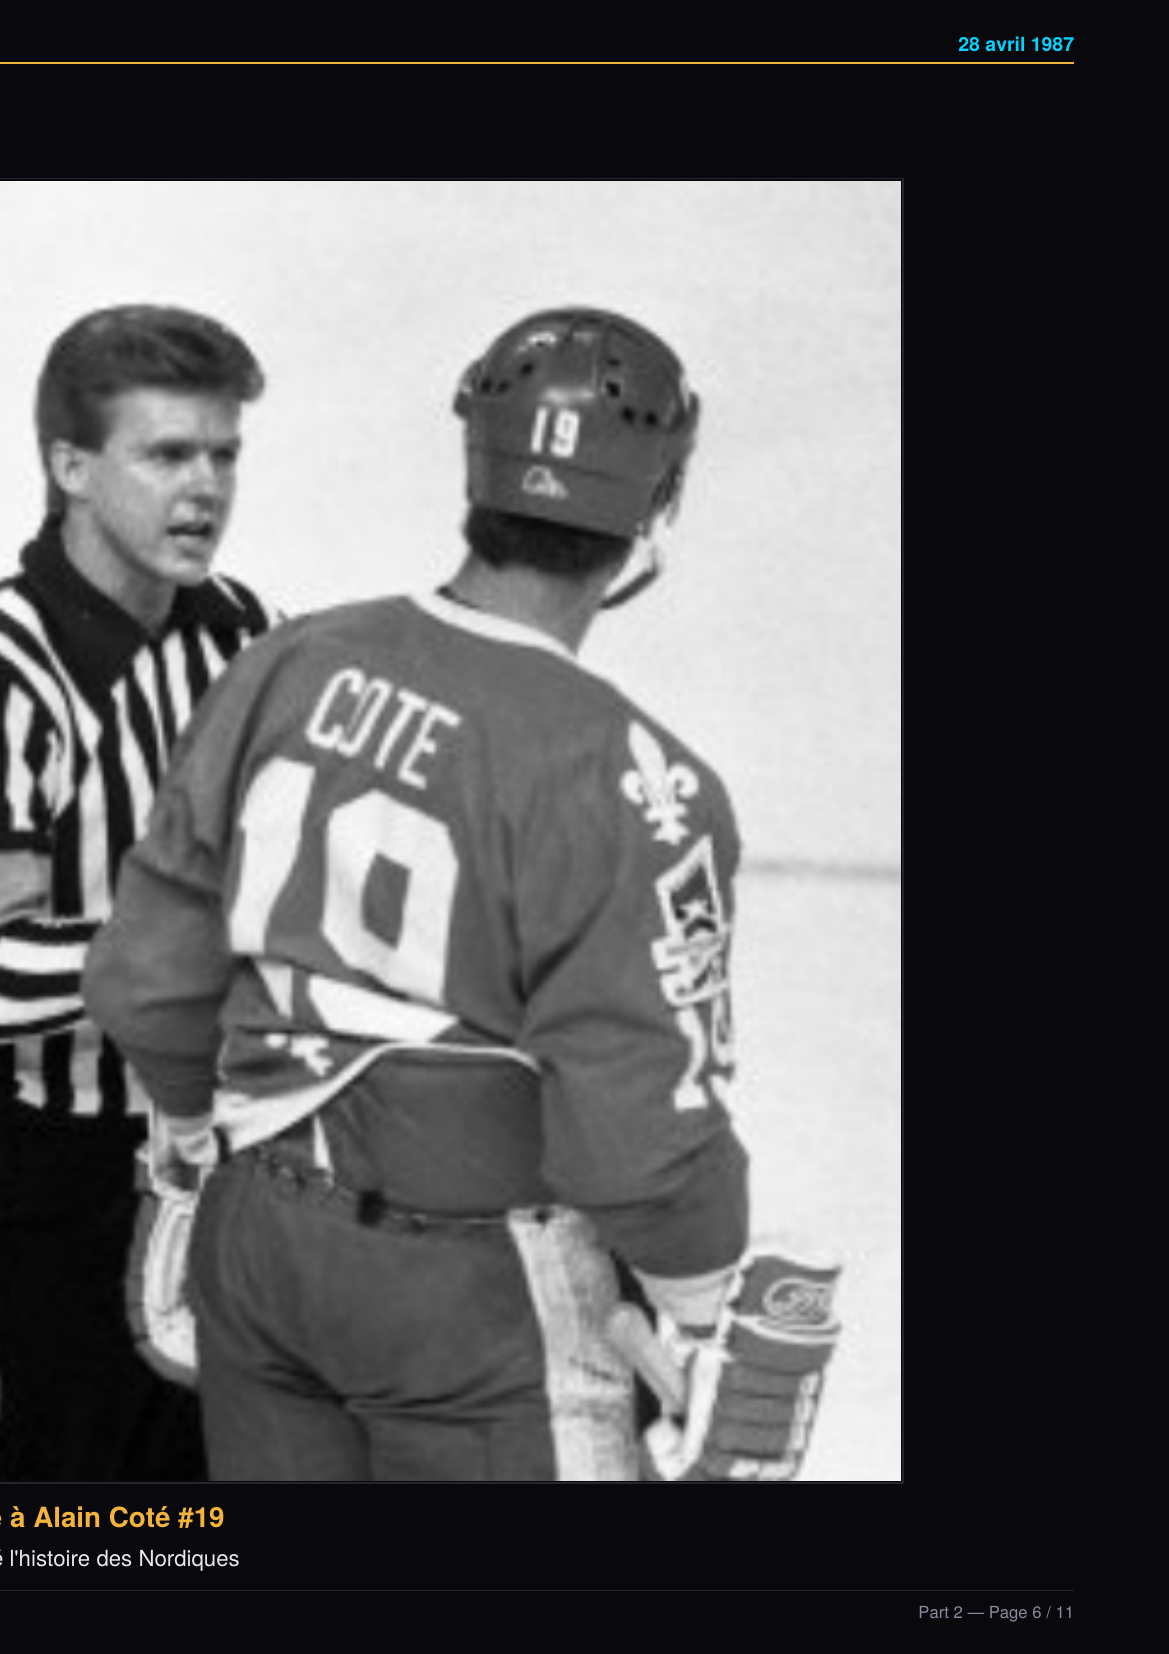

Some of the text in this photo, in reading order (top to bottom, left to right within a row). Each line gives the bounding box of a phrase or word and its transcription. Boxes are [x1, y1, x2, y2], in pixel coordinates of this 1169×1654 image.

[531, 405, 580, 458] 19
[305, 667, 462, 791] COTE
[227, 755, 460, 1010] 19
